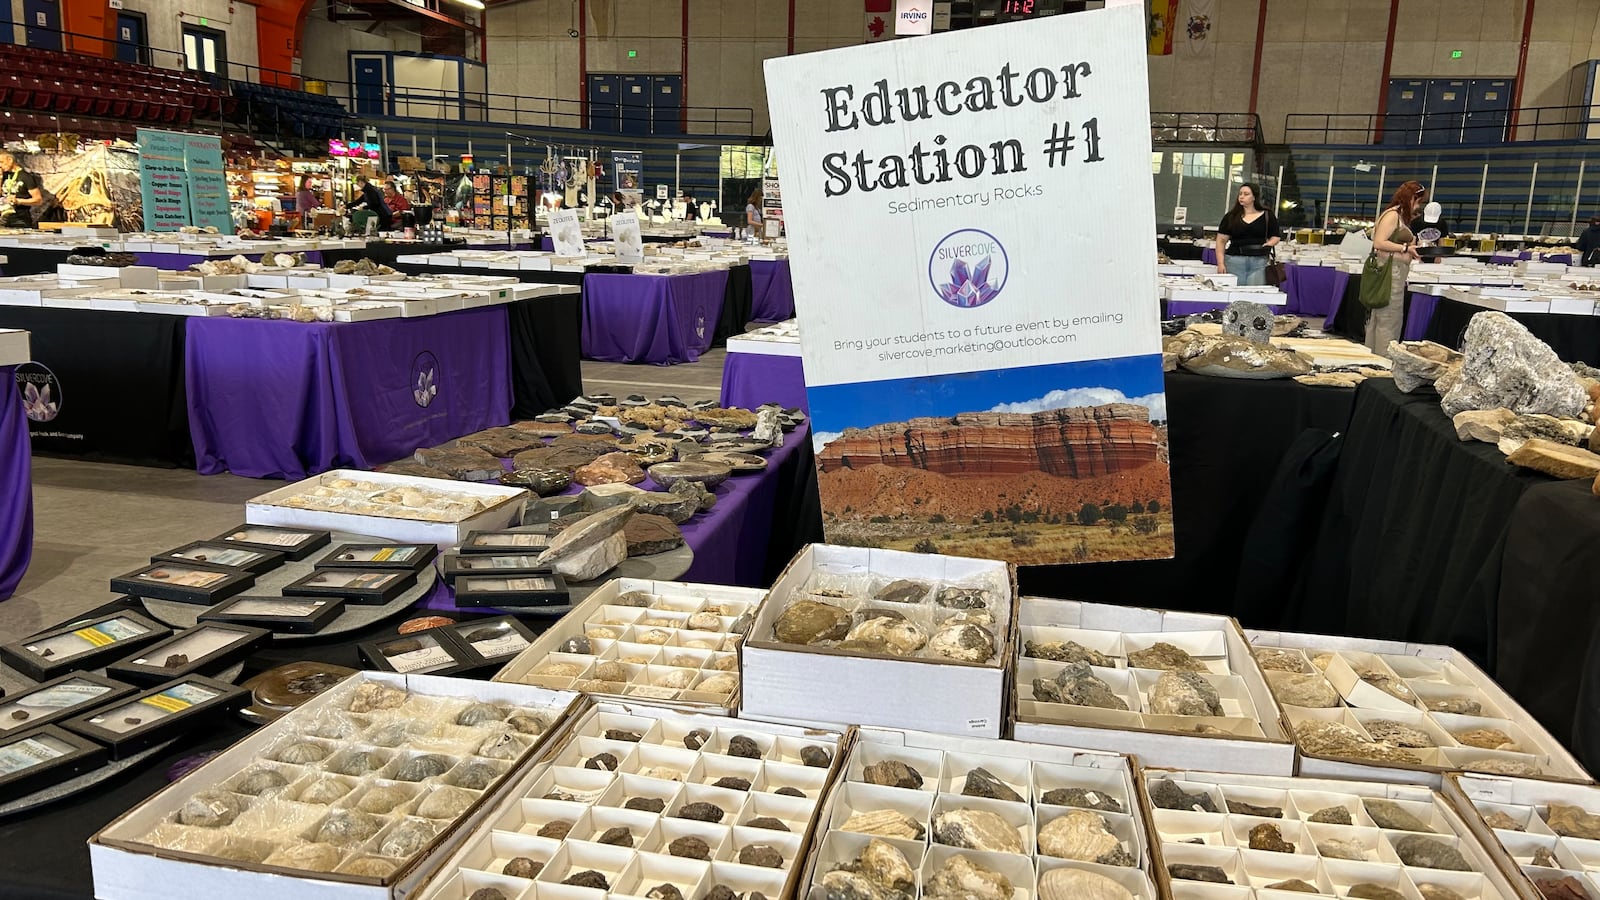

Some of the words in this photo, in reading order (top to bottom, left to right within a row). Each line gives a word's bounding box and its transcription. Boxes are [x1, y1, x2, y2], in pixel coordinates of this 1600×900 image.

[820, 61, 1092, 132] Educator
[822, 134, 1028, 197] Station
[1043, 117, 1104, 168] #1
[888, 192, 990, 214] Sedimentary
[553, 216, 574, 224] ZEOLITES
[938, 242, 996, 260] SILVERCOVE
[834, 340, 864, 350] Bring
[866, 336, 892, 349] your
[894, 331, 945, 344] students
[948, 330, 960, 338] to
[974, 325, 1012, 336] future
[1015, 320, 1050, 332] event
[1053, 316, 1070, 329] by
[1072, 312, 1124, 326] emailing
[878, 333, 1077, 362] silvercove_marketing@outlook.com
[16, 372, 53, 384] SILVERCOVE
